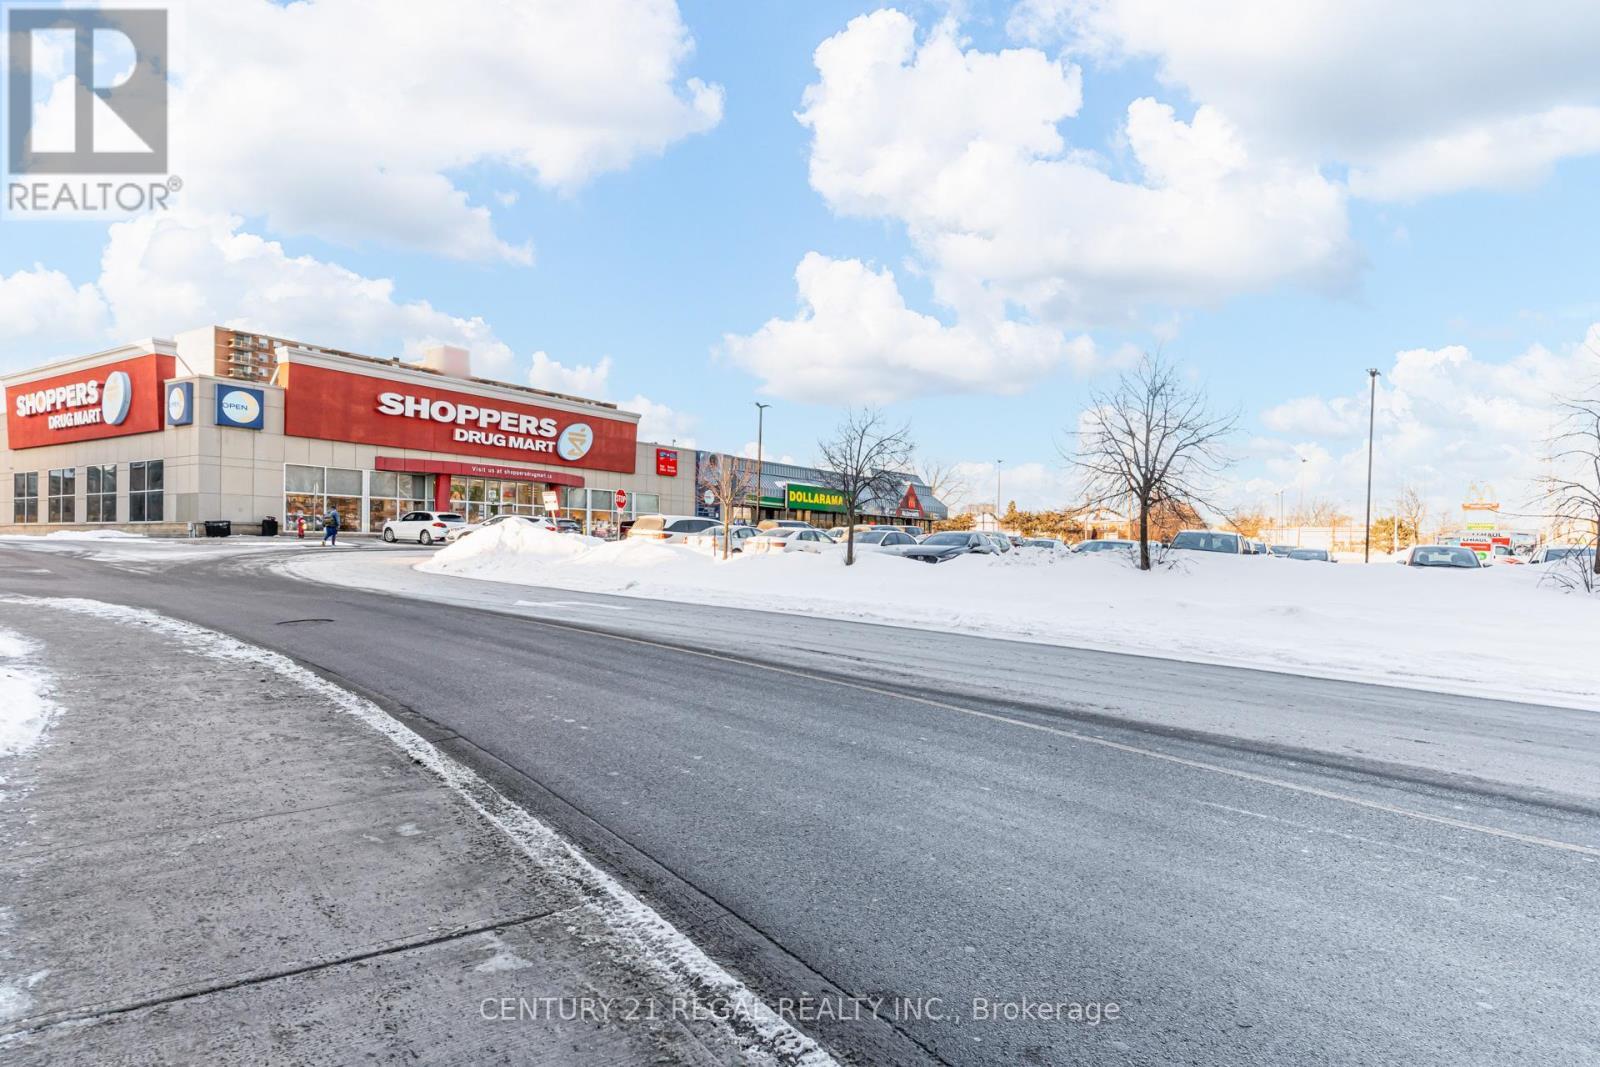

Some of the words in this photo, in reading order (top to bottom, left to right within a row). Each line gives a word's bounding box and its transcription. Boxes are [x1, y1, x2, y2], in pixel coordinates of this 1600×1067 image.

[16, 380, 99, 417] SHOPPERS
[222, 402, 248, 411] OPEN
[48, 412, 74, 430] DRUG
[74, 408, 101, 426] MART
[376, 392, 558, 438] SHOPPERS
[453, 428, 506, 447] DRUG
[508, 436, 556, 453] MART
[789, 490, 843, 506] DOLLARAMA
